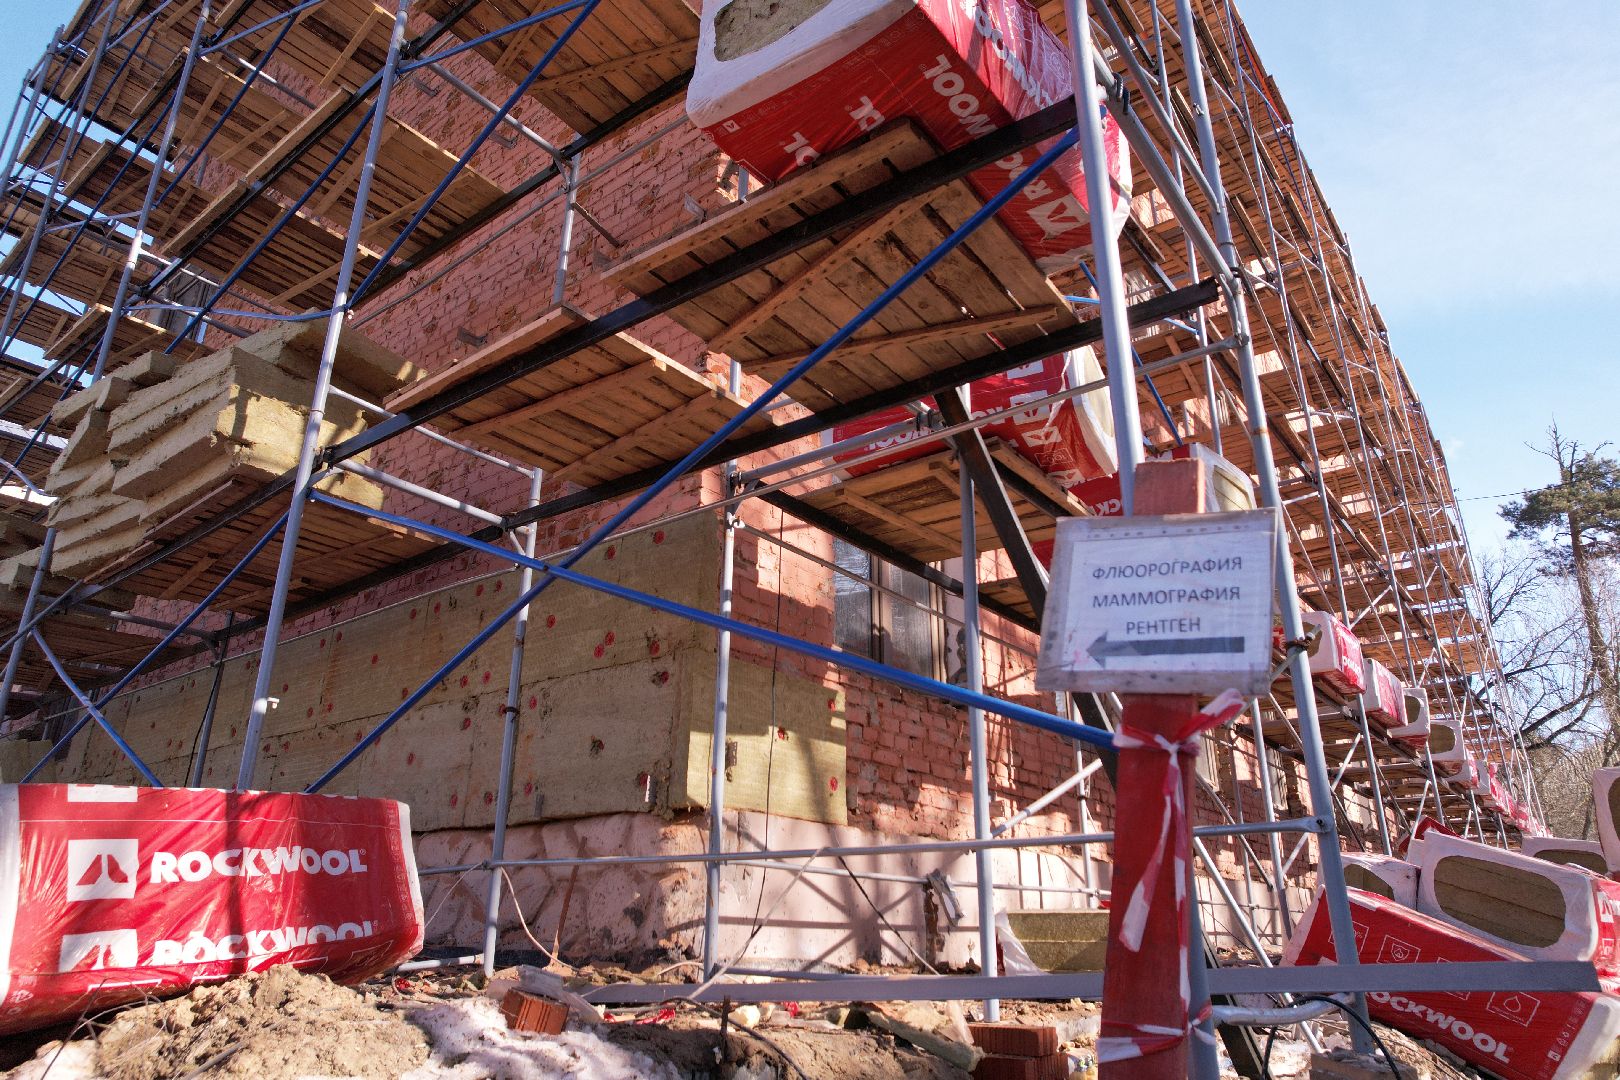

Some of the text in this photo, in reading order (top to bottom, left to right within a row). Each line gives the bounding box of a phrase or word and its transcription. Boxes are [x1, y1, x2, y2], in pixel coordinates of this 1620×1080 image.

[1092, 556, 1242, 580] ФЛЮОРОГРАФИЯ
[1092, 587, 1241, 608] МАММОГРАФИЯ
[1126, 617, 1201, 635] РЕНТГЕН
[150, 845, 368, 884] ROCKWOOL
[1366, 991, 1511, 1064] OCKWOOL
